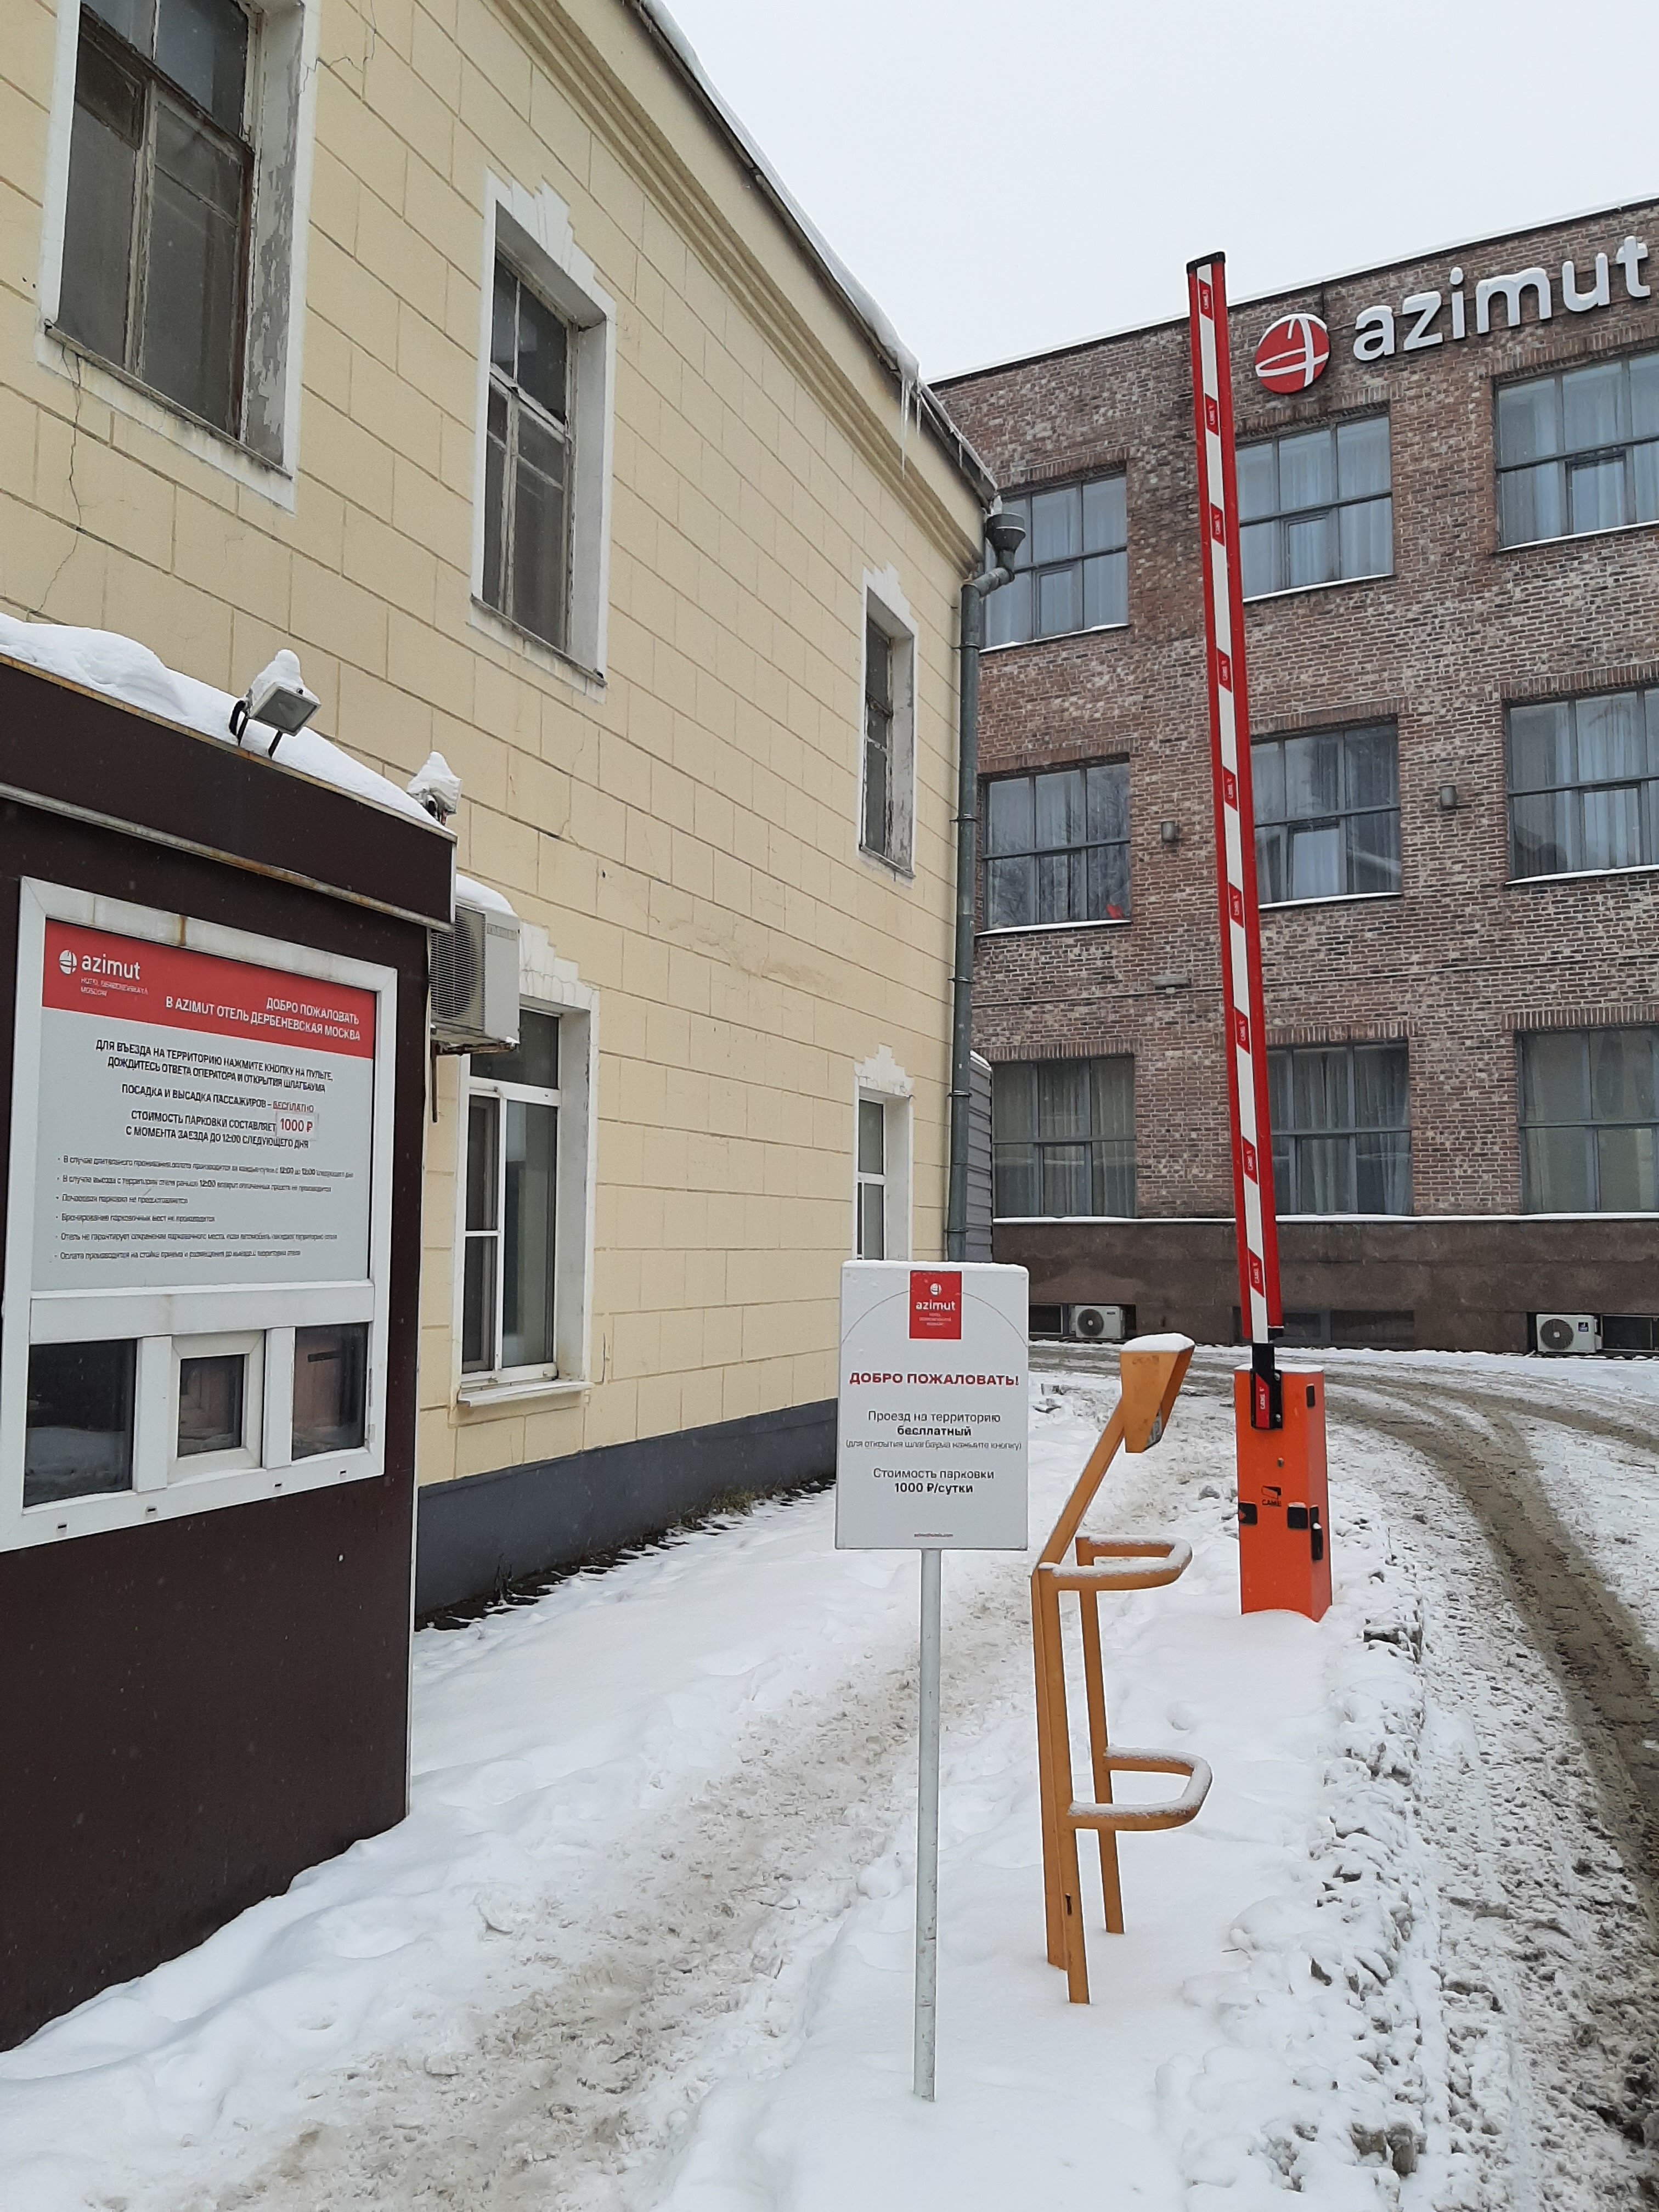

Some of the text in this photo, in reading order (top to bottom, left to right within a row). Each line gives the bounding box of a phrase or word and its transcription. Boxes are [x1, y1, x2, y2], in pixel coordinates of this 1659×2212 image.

[1353, 235, 1651, 362] azimut
[82, 953, 140, 980] azimut
[166, 996, 360, 1040] В AZIMUT ОТЕЛЬ ДЕРБЕНЕВСКАЯ МОСКВА
[266, 997, 359, 1025] ДОБРО ПОЖАЛОВАТЬ
[96, 1040, 114, 1051] ДЛЯ
[117, 1042, 151, 1057] ВЪЕЗДА
[153, 1047, 165, 1057] НА
[167, 1049, 222, 1065] ТЕРРИТОРИЮ
[223, 1058, 263, 1070] НАЖМИТЕ
[265, 1063, 294, 1075] КНОПКУ
[296, 1068, 304, 1077] НА
[108, 1057, 160, 1070] ДОЖДИТЕСЬ
[162, 1063, 191, 1075] ОТВЕТА
[193, 1068, 236, 1081] ОПЕРАТОРА
[244, 1074, 282, 1087] ОТКРЫТИЯ
[122, 1084, 162, 1097] ПОСАДКА
[165, 1088, 170, 1098] И
[173, 1090, 211, 1103] ВЫСАДКА
[213, 1094, 266, 1108] ПАССАЖИРОВ
[131, 1110, 183, 1124] СТОИМОСТЬ
[185, 1115, 227, 1127] ПАРКОВКИ
[229, 1119, 276, 1132] СОСТАВЛЯЕТ
[280, 1118, 304, 1132] 1000
[126, 1126, 132, 1136] С
[134, 1126, 176, 1138] МОМЕНТА
[178, 1130, 208, 1142] ЗАЕЗДА
[210, 1132, 221, 1143] ДО
[294, 1139, 308, 1149] ДНЯ
[916, 1299, 956, 1311] azimut
[850, 1373, 1019, 1386] ДОБРО ПОЖАЛОВАТЬ!
[868, 1410, 911, 1422] Проезд
[932, 1413, 1001, 1423] территорию
[897, 1425, 972, 1436] бесплатный
[873, 1468, 994, 1480] Стоимость парковки
[895, 1483, 923, 1493] 1000
